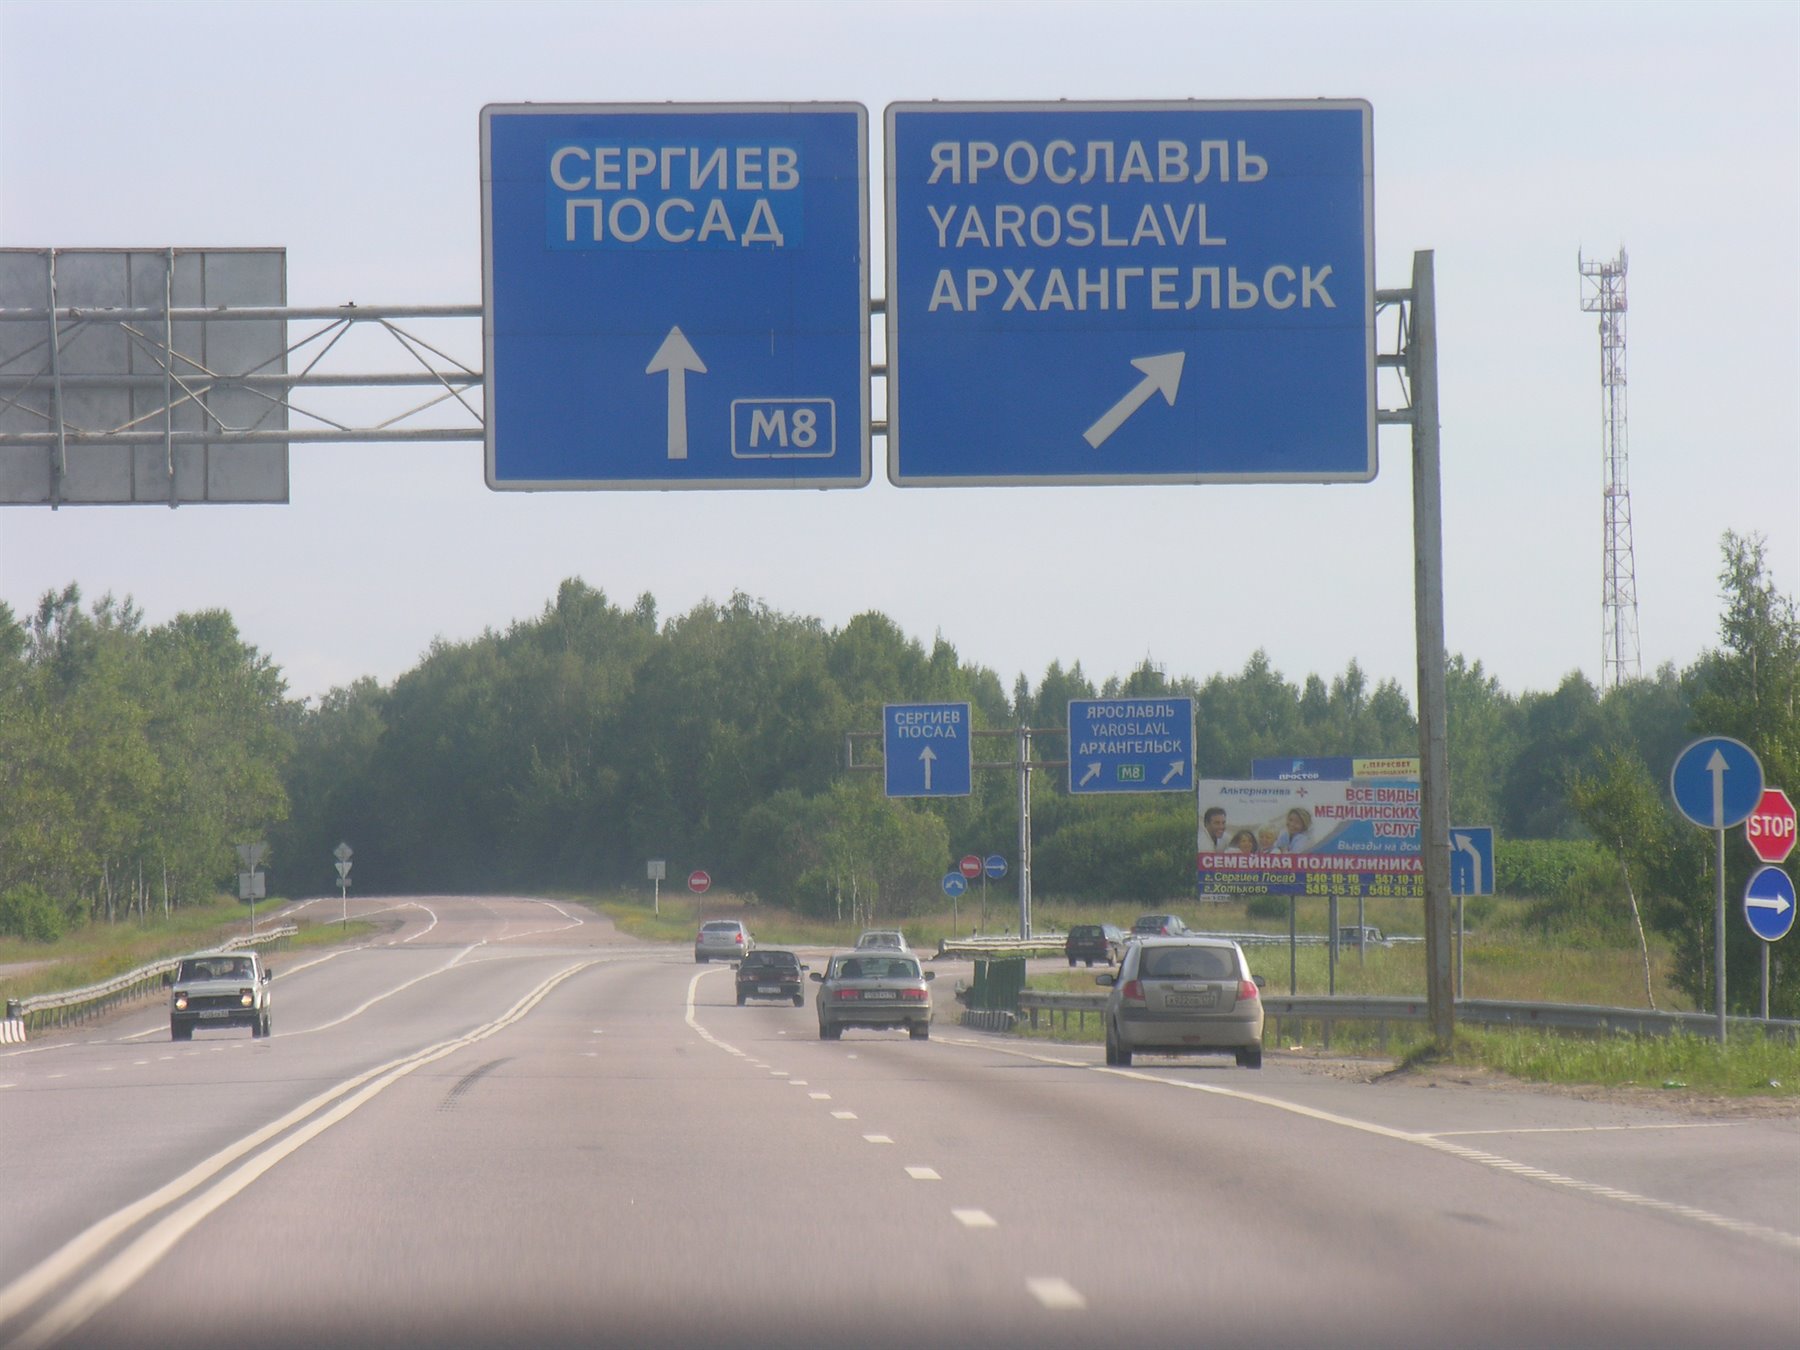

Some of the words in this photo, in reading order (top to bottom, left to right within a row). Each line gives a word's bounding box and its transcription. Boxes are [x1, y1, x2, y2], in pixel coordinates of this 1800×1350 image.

[550, 146, 800, 191] СЕРГИЕВ
[926, 139, 1269, 185] ЯРОСЛАВЛЬ
[566, 198, 784, 247] ПОСАД
[926, 203, 1227, 248] YAROSLAVL
[928, 264, 1336, 312] АРХАНГЕЛЬСК
[894, 710, 961, 725] СЕРГИЕВ
[1086, 704, 1175, 719] ЯРОСЛАВЛЬ
[898, 725, 957, 738] ПОСАД
[1091, 722, 1170, 736] YAROSLAVL
[1079, 740, 1183, 755] АРХАНГЕЛЬСК
[1220, 786, 1291, 797] Альтернатива
[1345, 788, 1374, 801] ВСЕ
[1377, 788, 1420, 804] ВИДЫ
[1314, 805, 1420, 820] МЕДИЦИНСКИХ
[1375, 823, 1418, 836] УСЛУГ
[1750, 815, 1794, 838] STOP
[1202, 854, 1293, 869] СЕМЕЙНАЯ
[1298, 857, 1423, 871] ПОЛИКЛИНИКА
[1262, 873, 1296, 883] Посад
